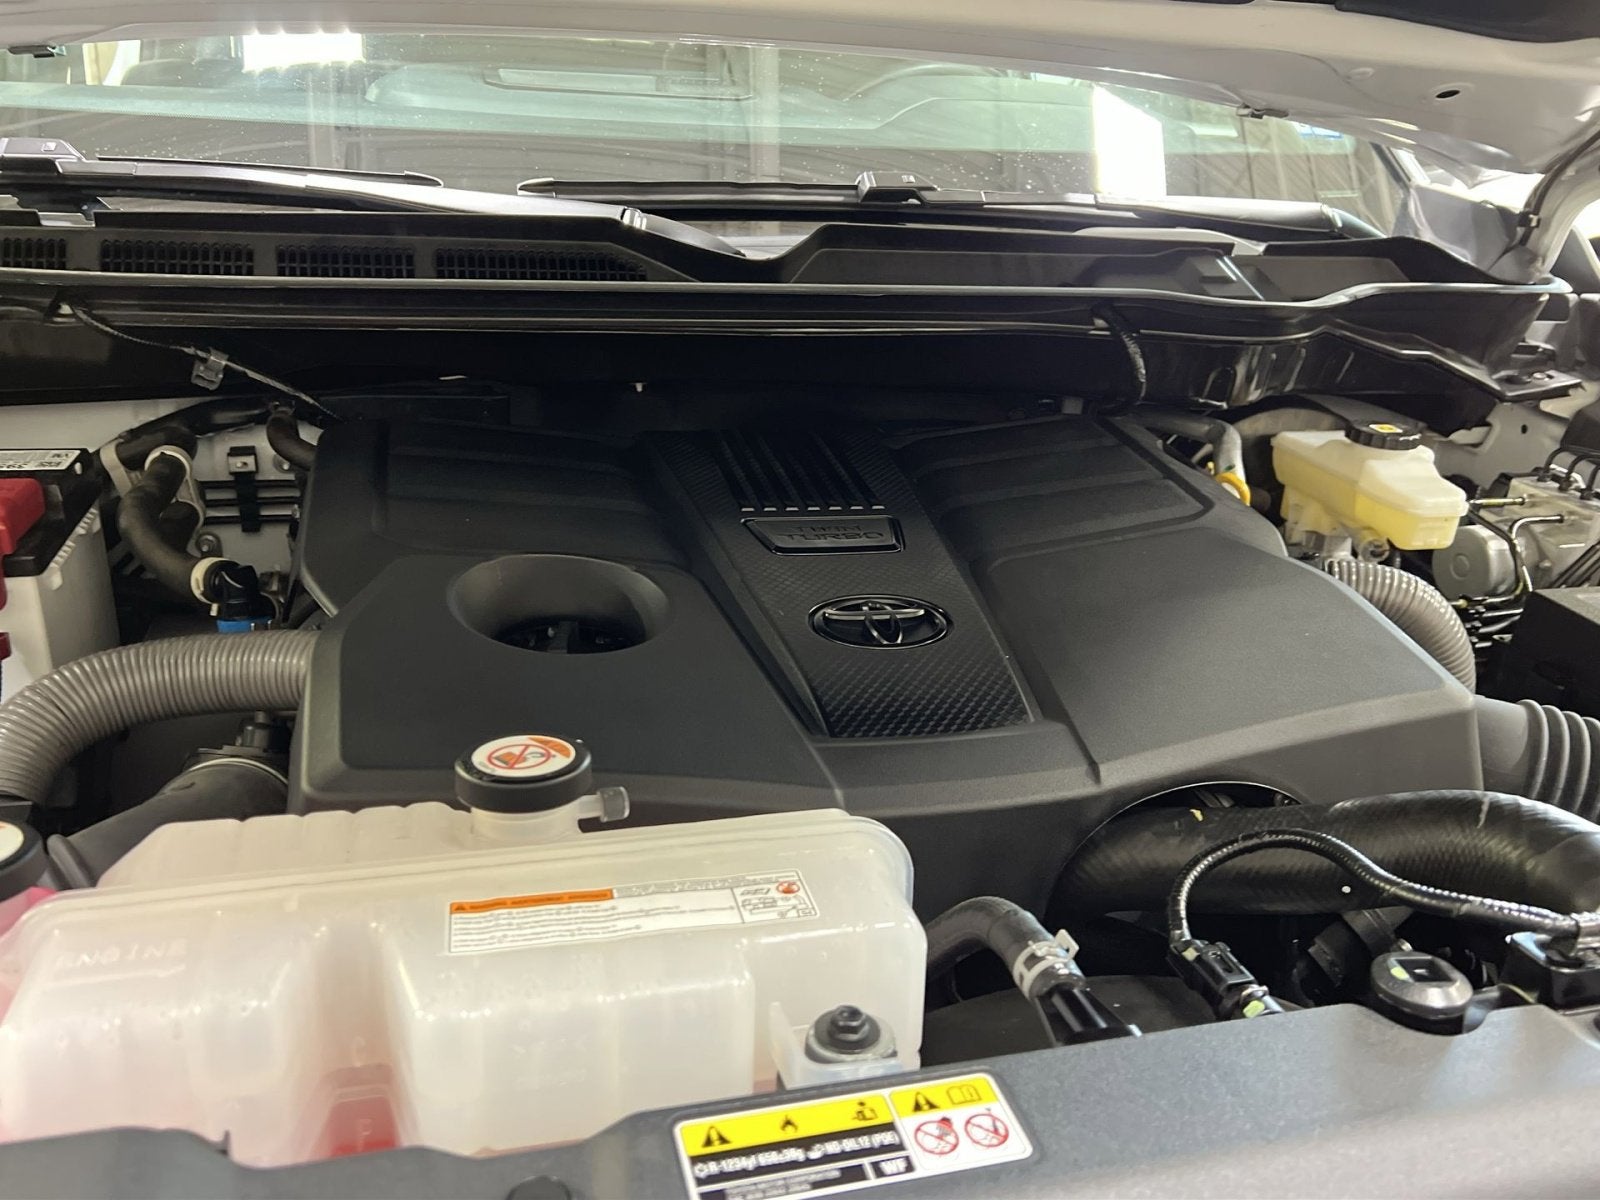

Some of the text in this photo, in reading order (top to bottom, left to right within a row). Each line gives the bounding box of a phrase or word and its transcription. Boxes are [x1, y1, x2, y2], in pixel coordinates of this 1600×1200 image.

[777, 531, 885, 541] TURBO
[55, 939, 187, 967] ENGINE
[879, 1157, 908, 1176] WF
